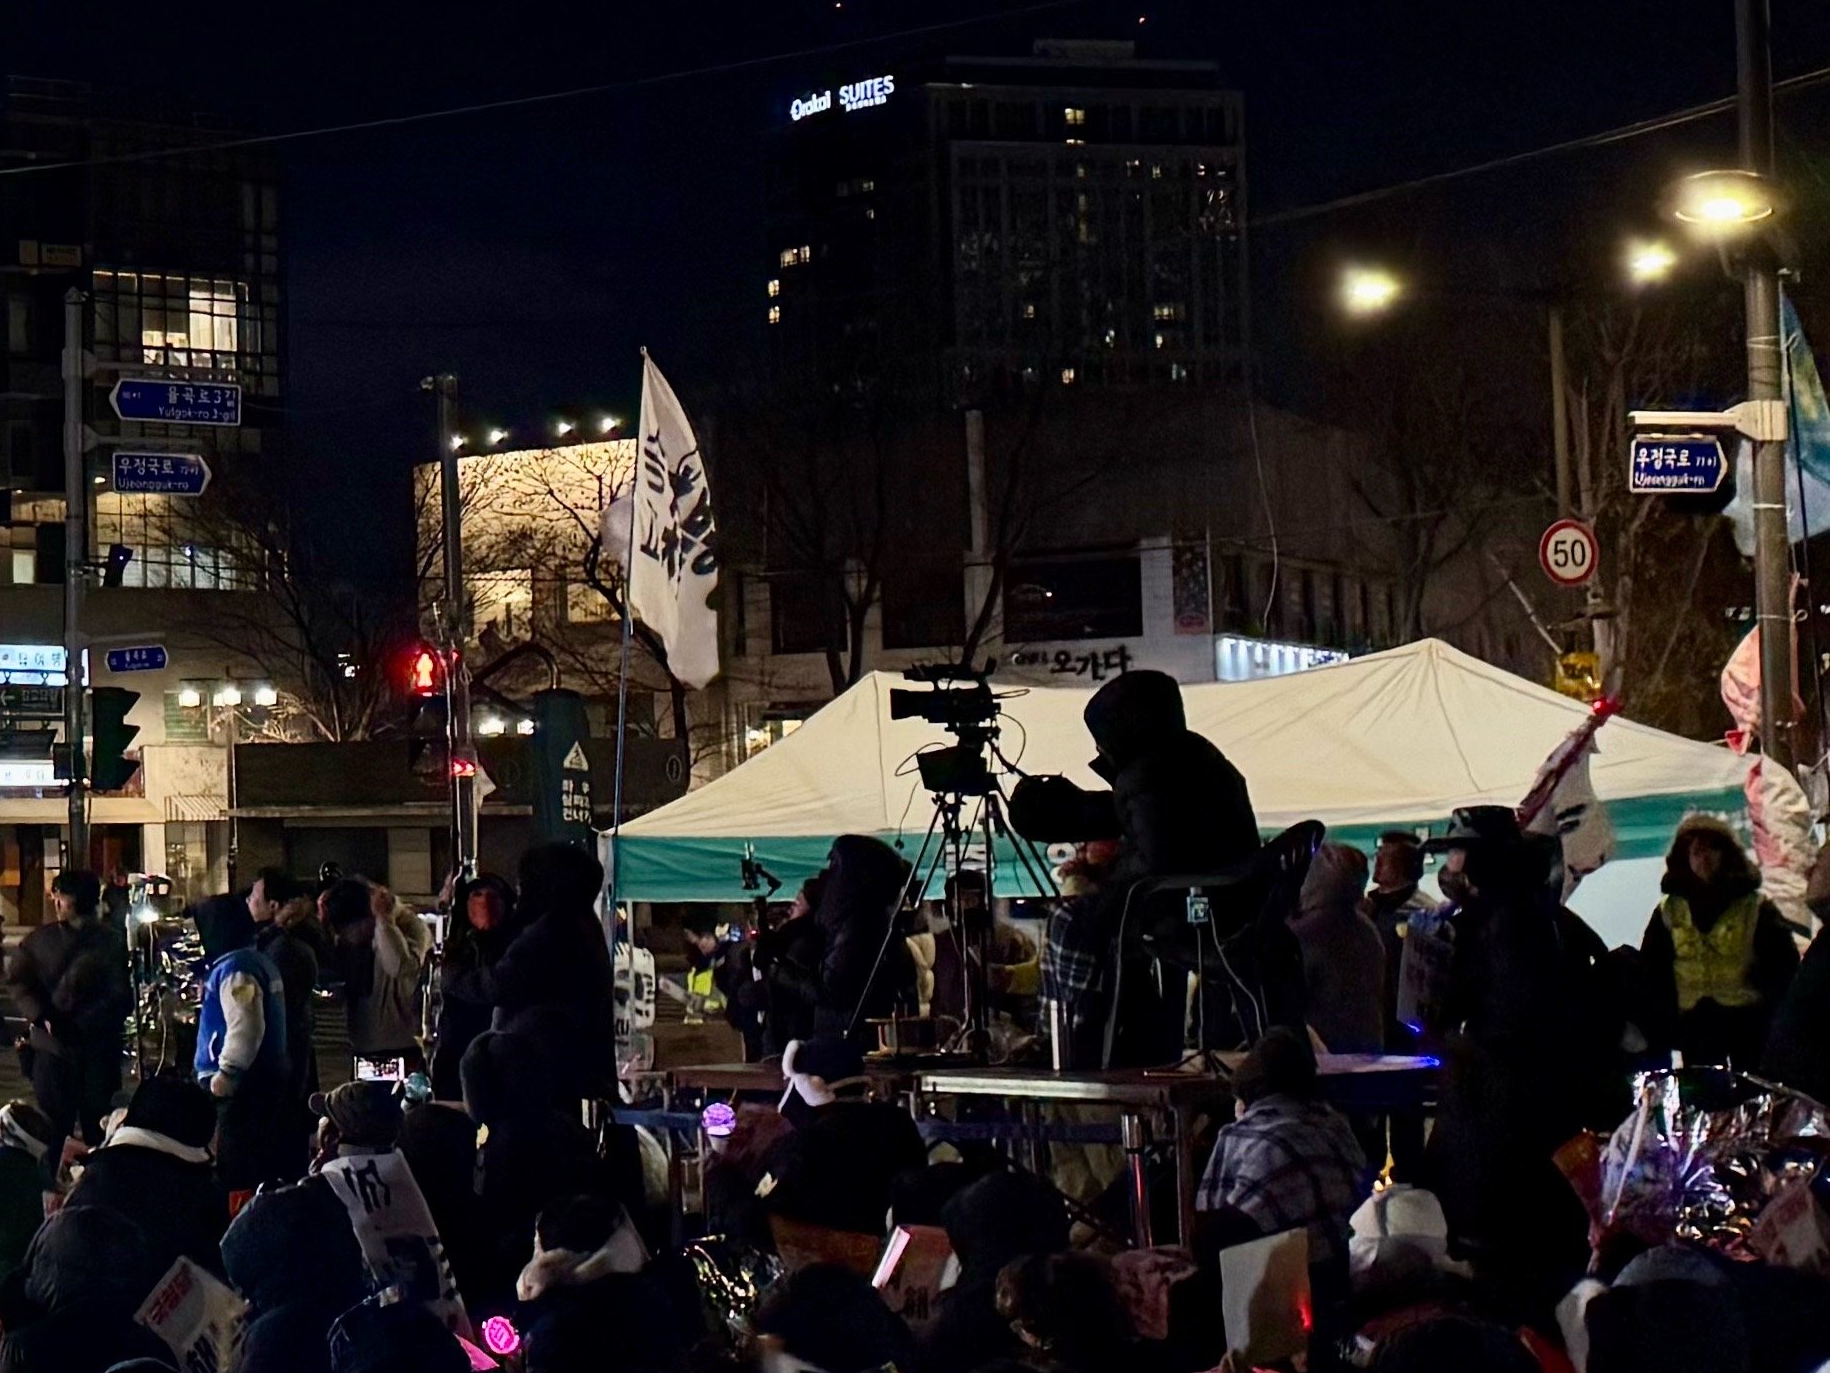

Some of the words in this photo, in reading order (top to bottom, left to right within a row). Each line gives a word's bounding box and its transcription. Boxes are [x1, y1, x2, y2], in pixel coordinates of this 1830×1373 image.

[840, 75, 895, 105] SUITES
[1635, 446, 1691, 471] 우정국로
[1553, 538, 1587, 569] 50
